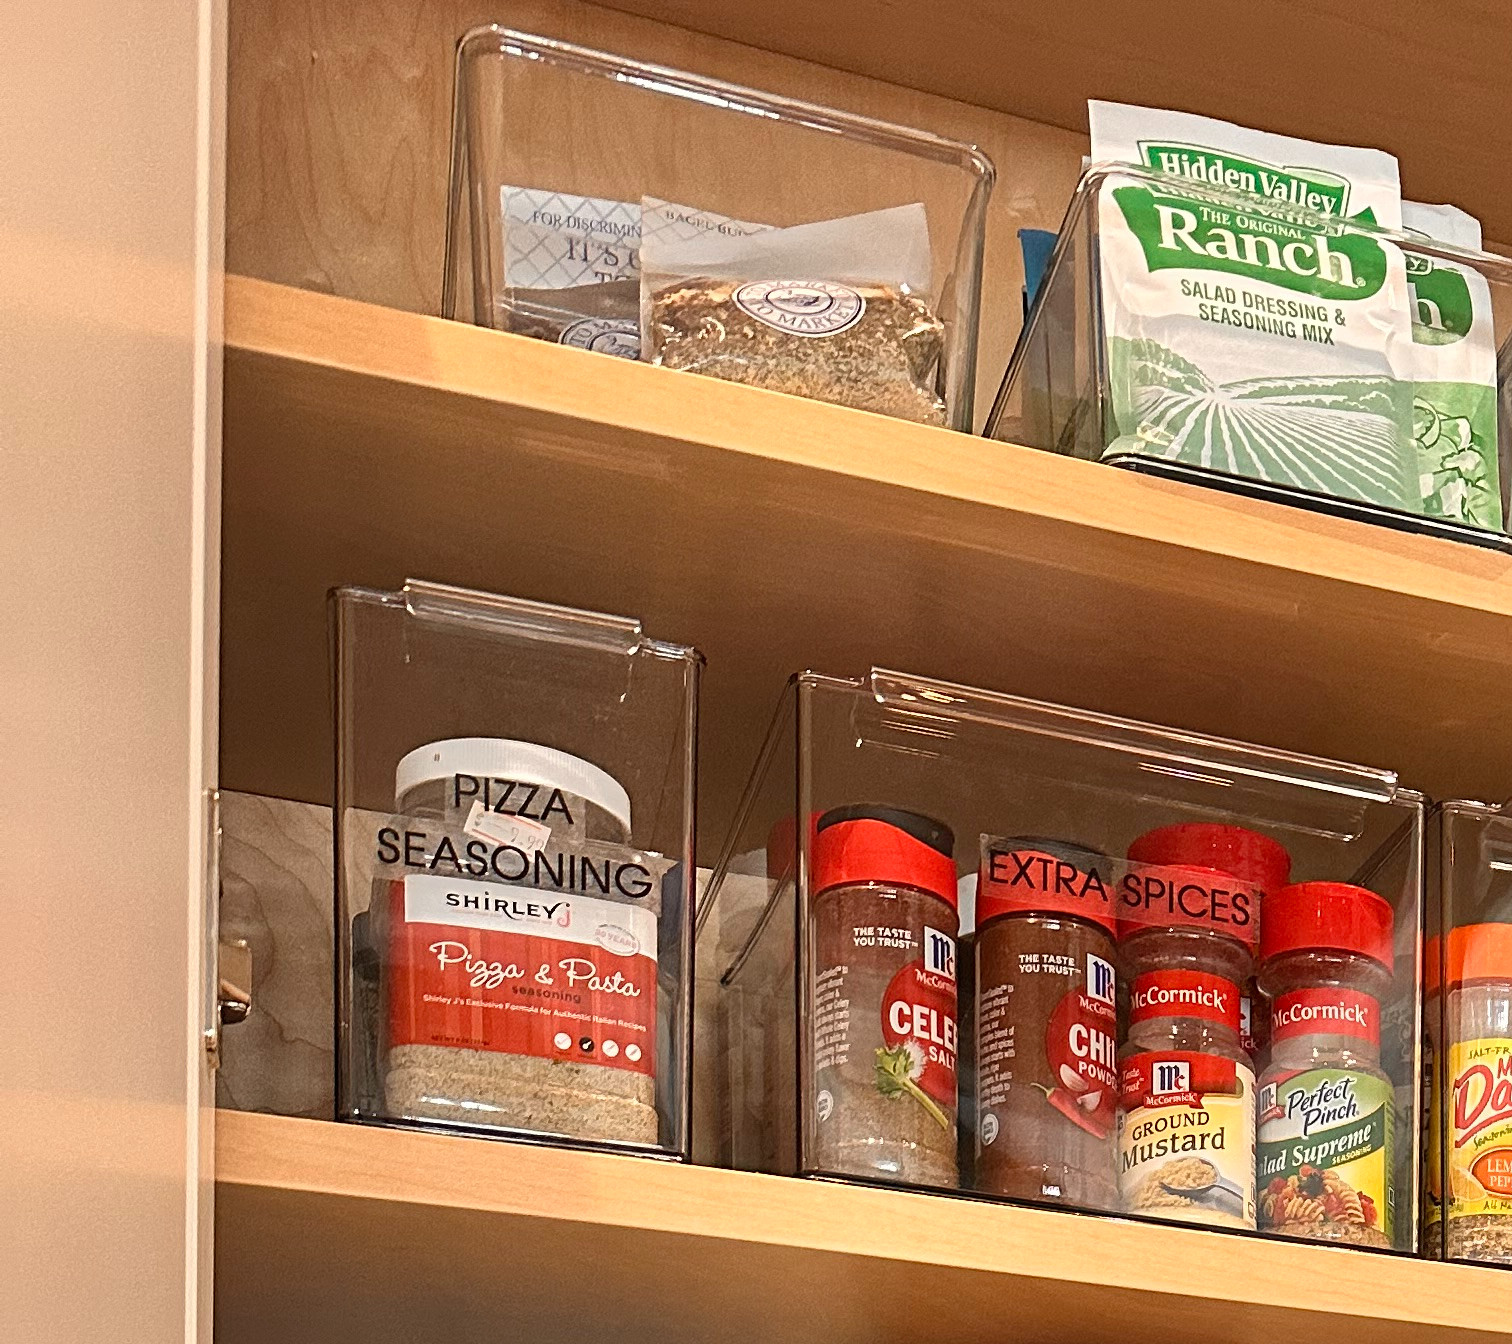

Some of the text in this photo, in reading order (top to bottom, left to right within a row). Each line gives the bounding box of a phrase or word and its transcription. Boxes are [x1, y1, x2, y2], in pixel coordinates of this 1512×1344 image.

[1159, 152, 1337, 214] Hidden Valley
[1154, 203, 1357, 289] Ranch
[779, 303, 855, 330] MARKET
[1180, 278, 1331, 322] SALAD DRESSING
[1199, 303, 1334, 345] SEASONING MIX
[454, 773, 574, 824] PIZZA
[377, 827, 653, 898] SEASONING
[989, 849, 1250, 926] EXTRA SPICES
[429, 941, 641, 997] Pizza Pasta
[1132, 1112, 1210, 1141] GROUND
[1292, 1124, 1372, 1167] Supreme
[1122, 1128, 1225, 1174] Mustard
